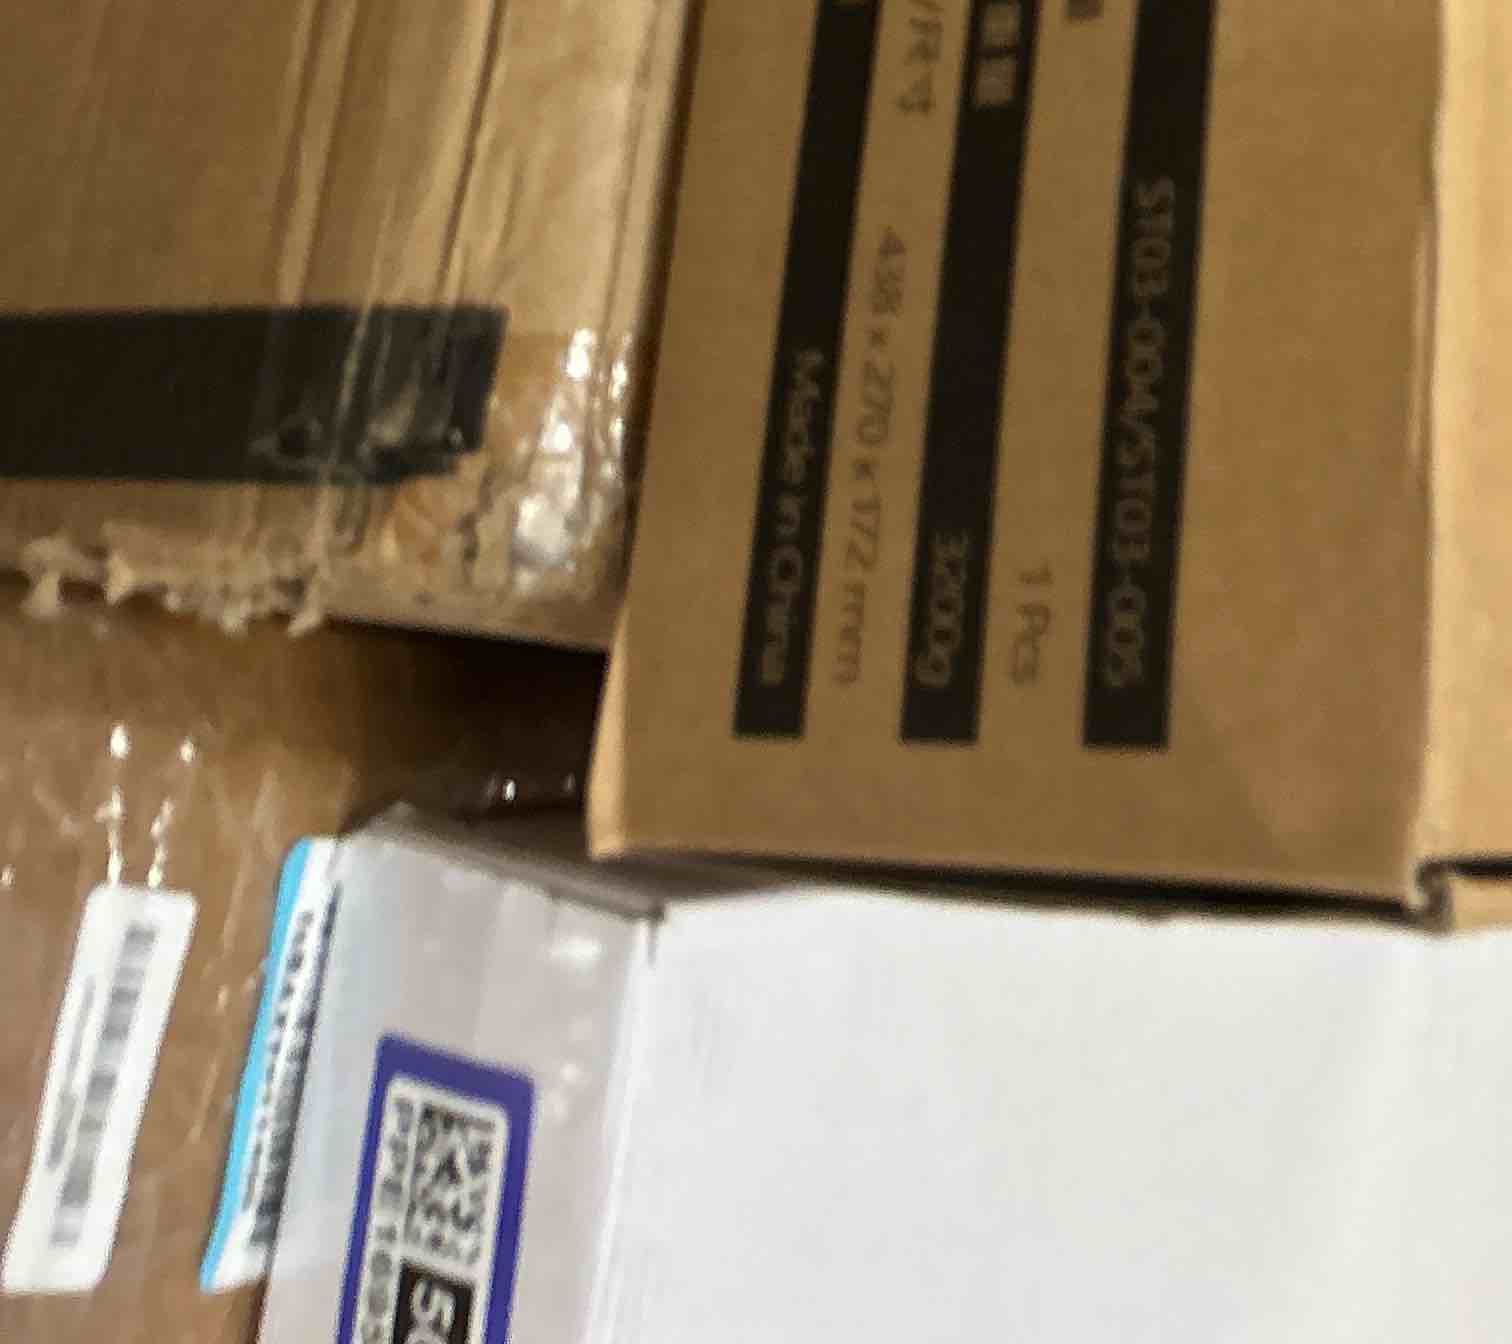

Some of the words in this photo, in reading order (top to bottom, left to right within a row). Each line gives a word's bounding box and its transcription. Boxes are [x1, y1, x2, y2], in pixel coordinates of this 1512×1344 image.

[780, 348, 826, 482] Made
[856, 359, 896, 445] 270
[775, 494, 804, 537] in
[844, 495, 882, 572] 172
[759, 543, 802, 688] China
[831, 581, 867, 688] mm
